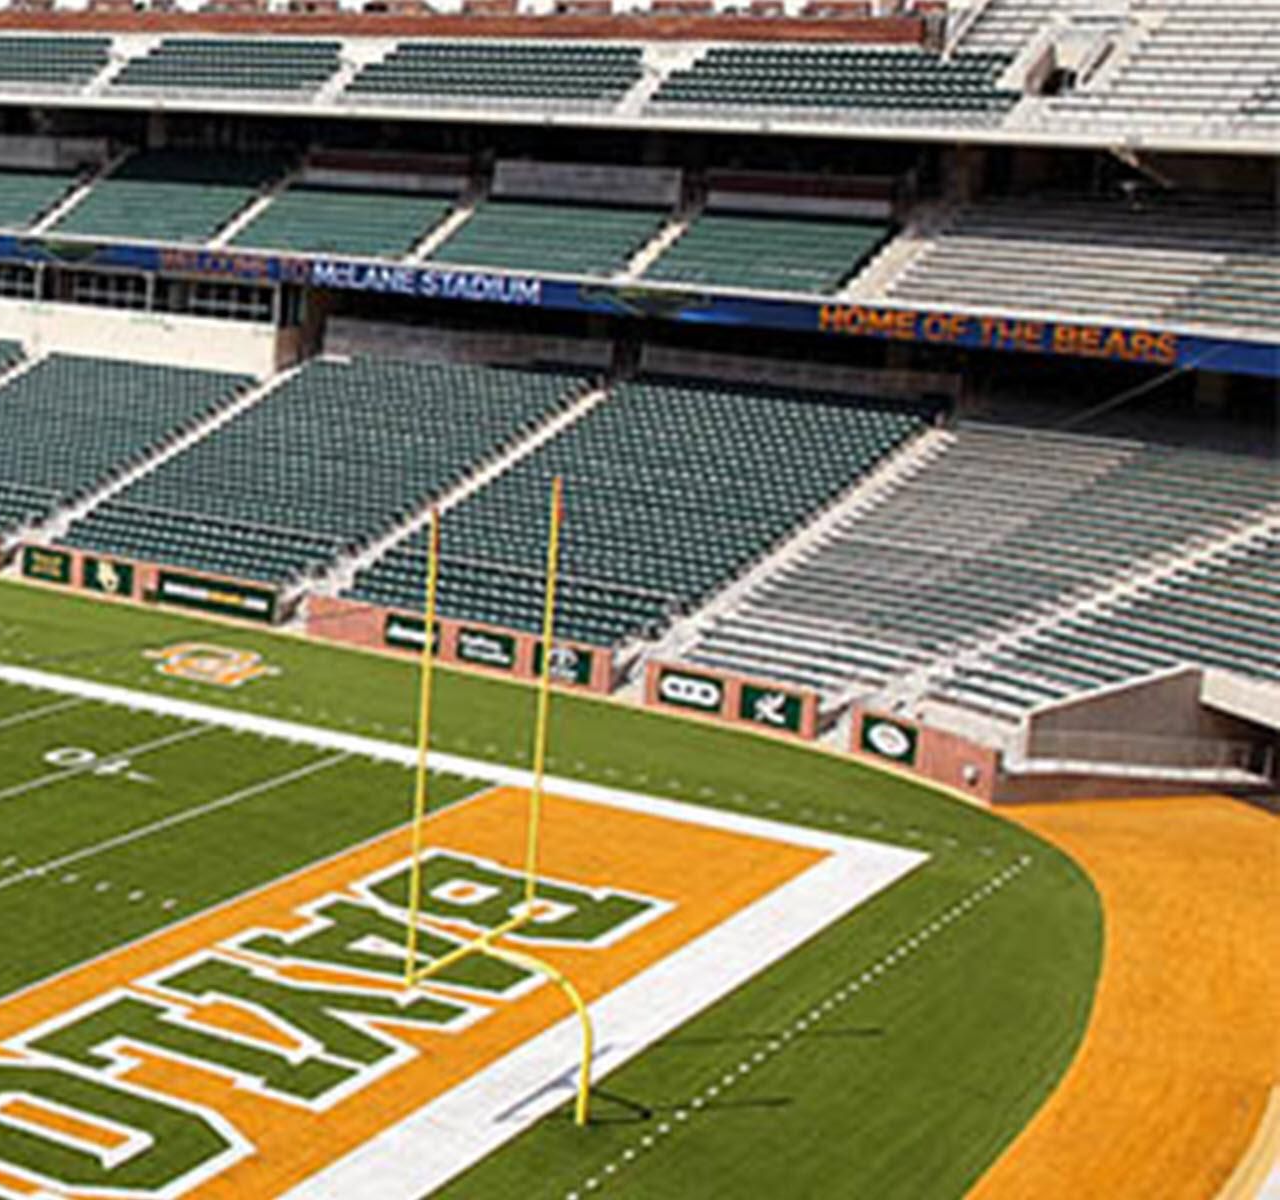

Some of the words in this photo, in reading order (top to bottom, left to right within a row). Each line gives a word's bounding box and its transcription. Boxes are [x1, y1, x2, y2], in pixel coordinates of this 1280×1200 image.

[421, 271, 541, 305] STADIUM
[818, 303, 917, 340] HOME
[924, 311, 967, 343] OF
[979, 317, 1041, 352] THE
[1053, 324, 1178, 363] BEARS
